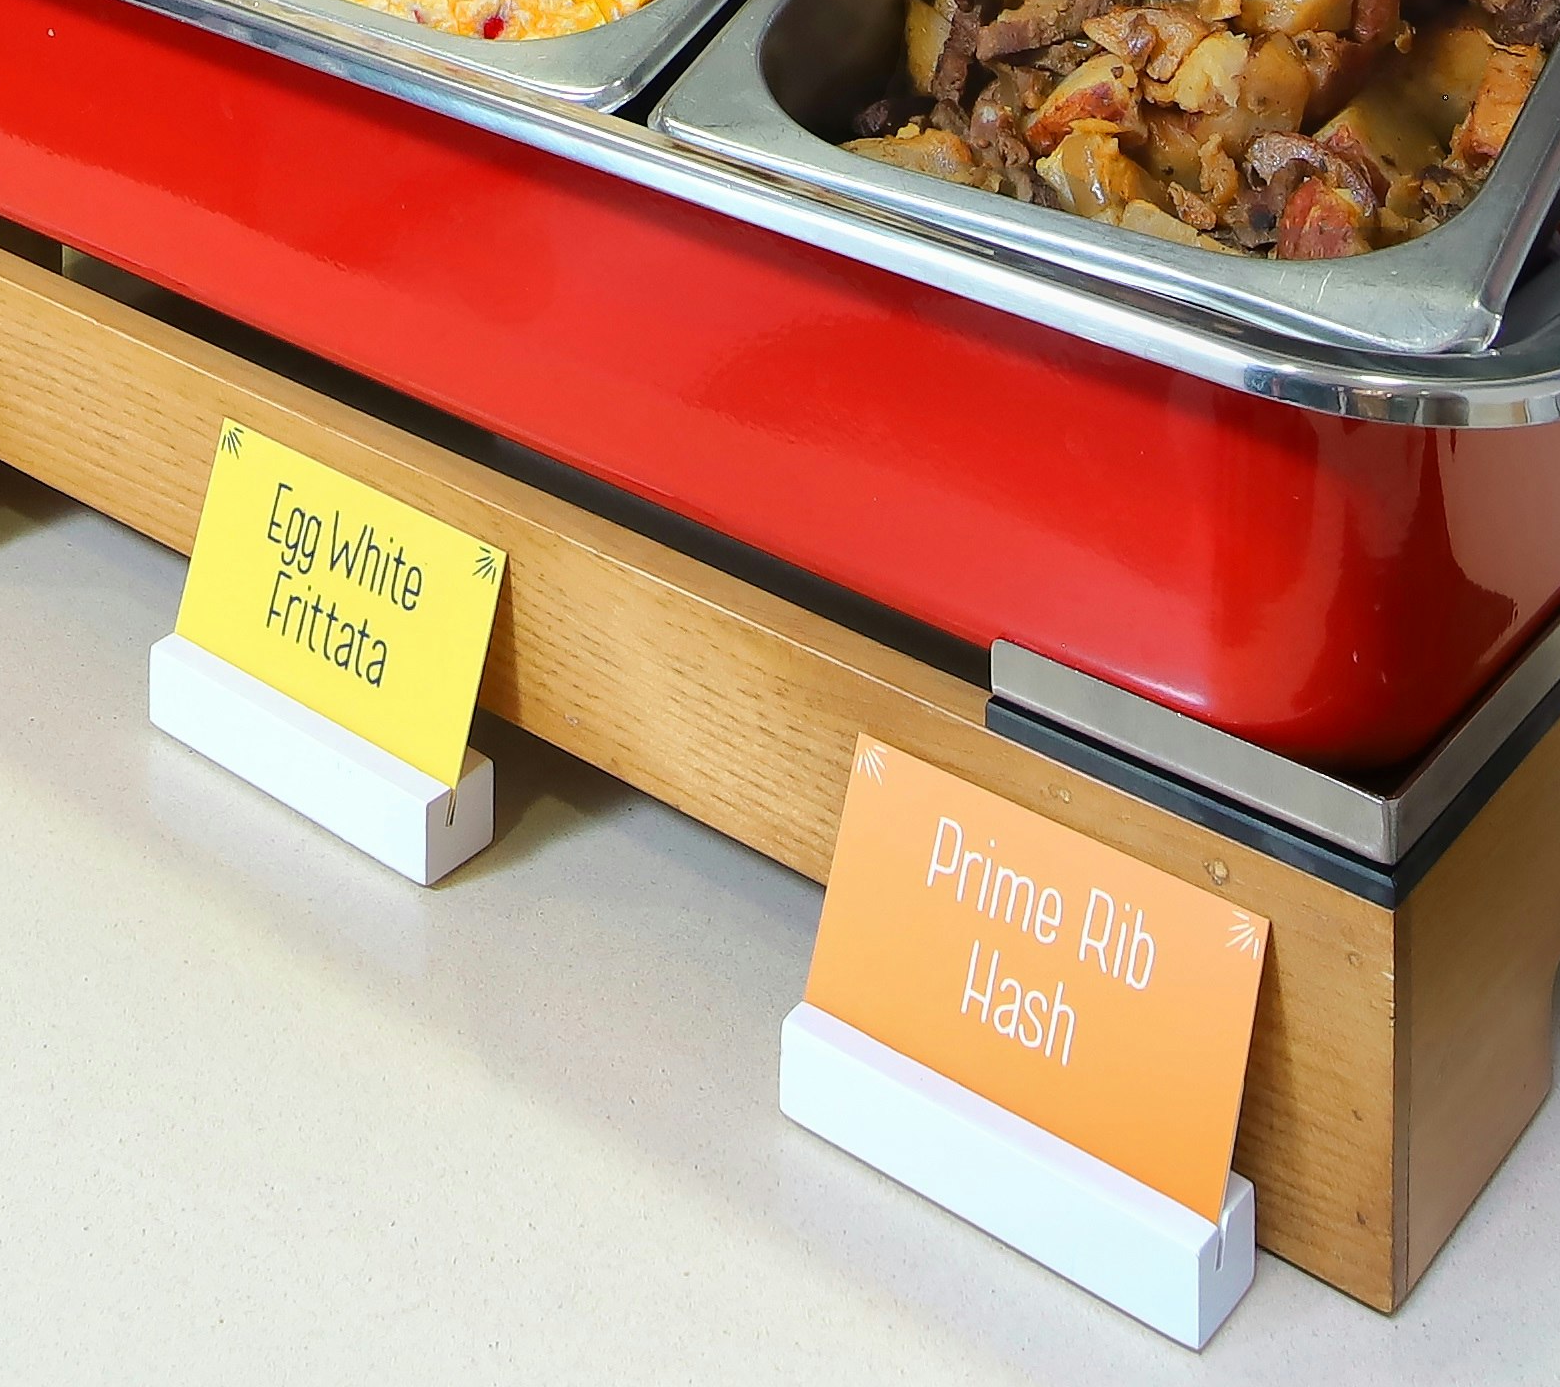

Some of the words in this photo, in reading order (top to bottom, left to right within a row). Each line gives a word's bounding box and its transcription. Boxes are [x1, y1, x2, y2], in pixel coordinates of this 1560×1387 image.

[266, 482, 323, 574] Egg
[329, 510, 423, 611] White
[266, 571, 389, 688] Frittata
[925, 815, 1064, 945] Prime
[1078, 886, 1157, 991] Rib
[960, 939, 1077, 1067] Hash
